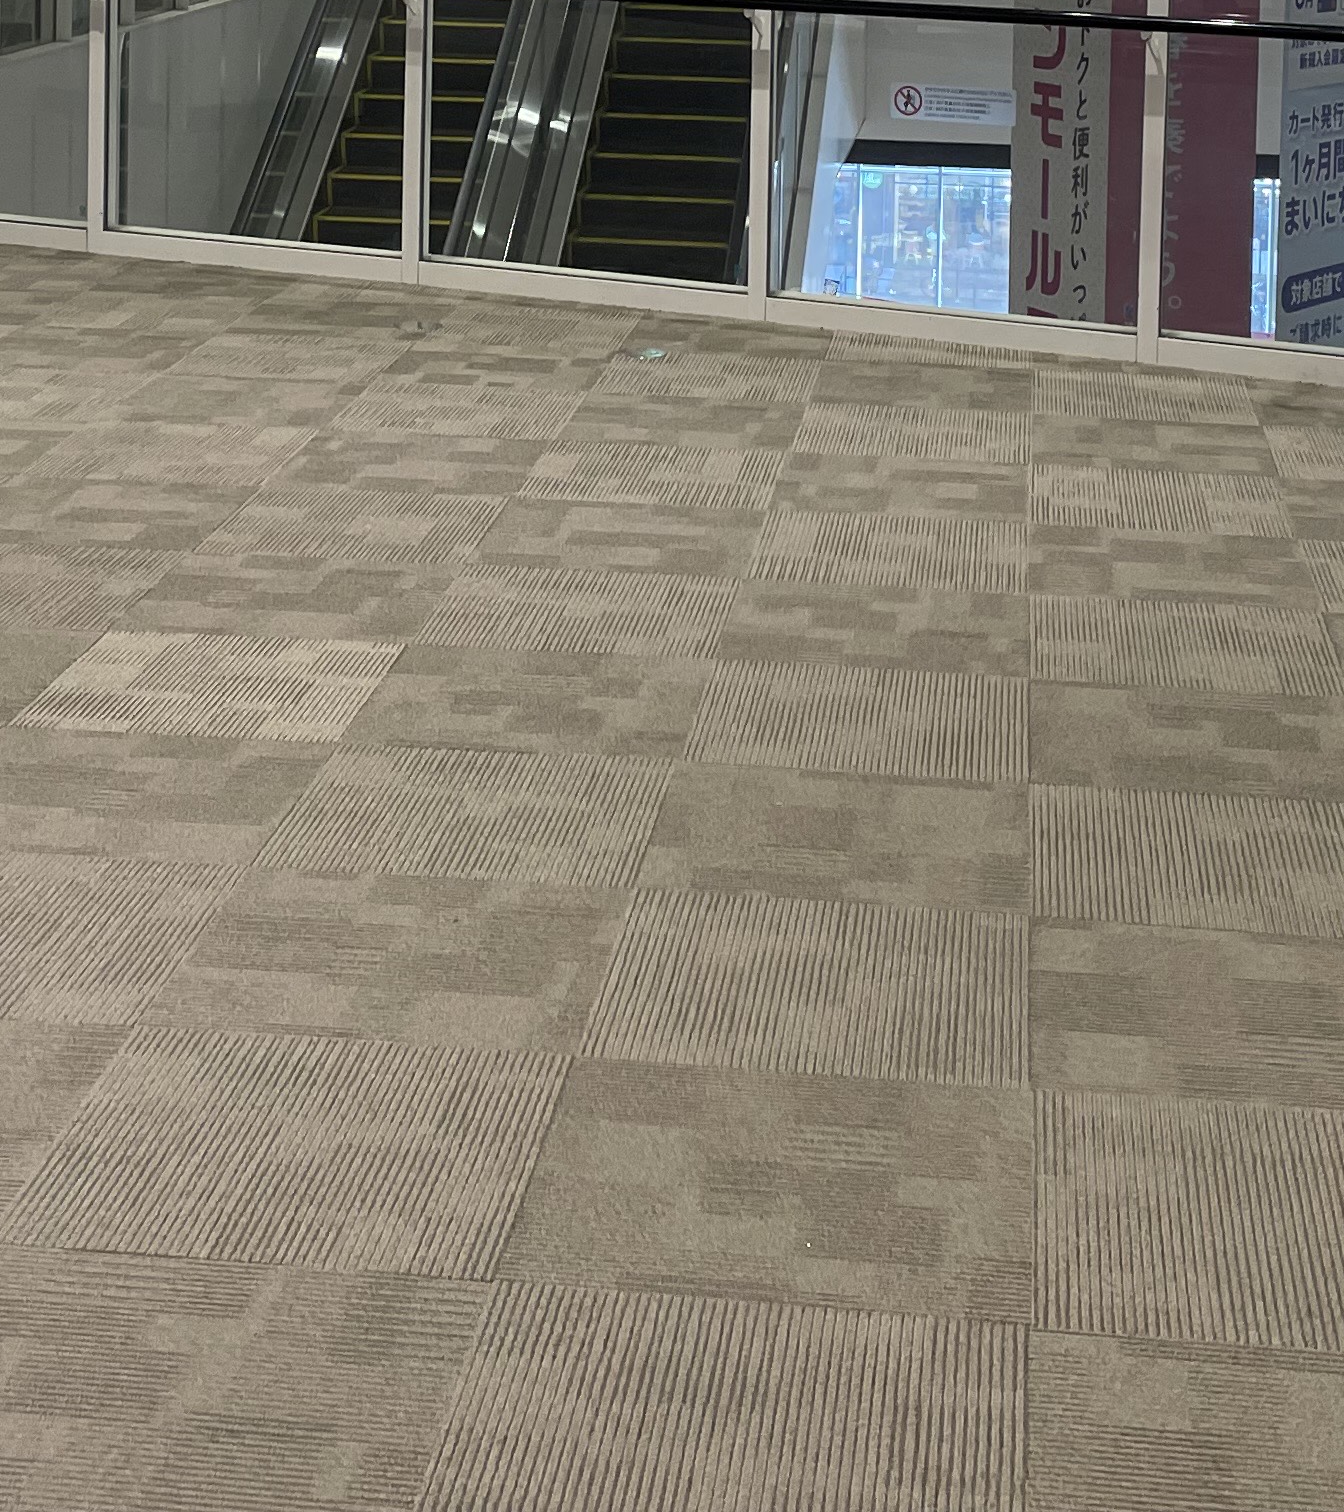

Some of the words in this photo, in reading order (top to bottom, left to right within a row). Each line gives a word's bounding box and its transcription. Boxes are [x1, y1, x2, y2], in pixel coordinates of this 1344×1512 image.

[1290, 271, 1343, 306] 対象店舗で
